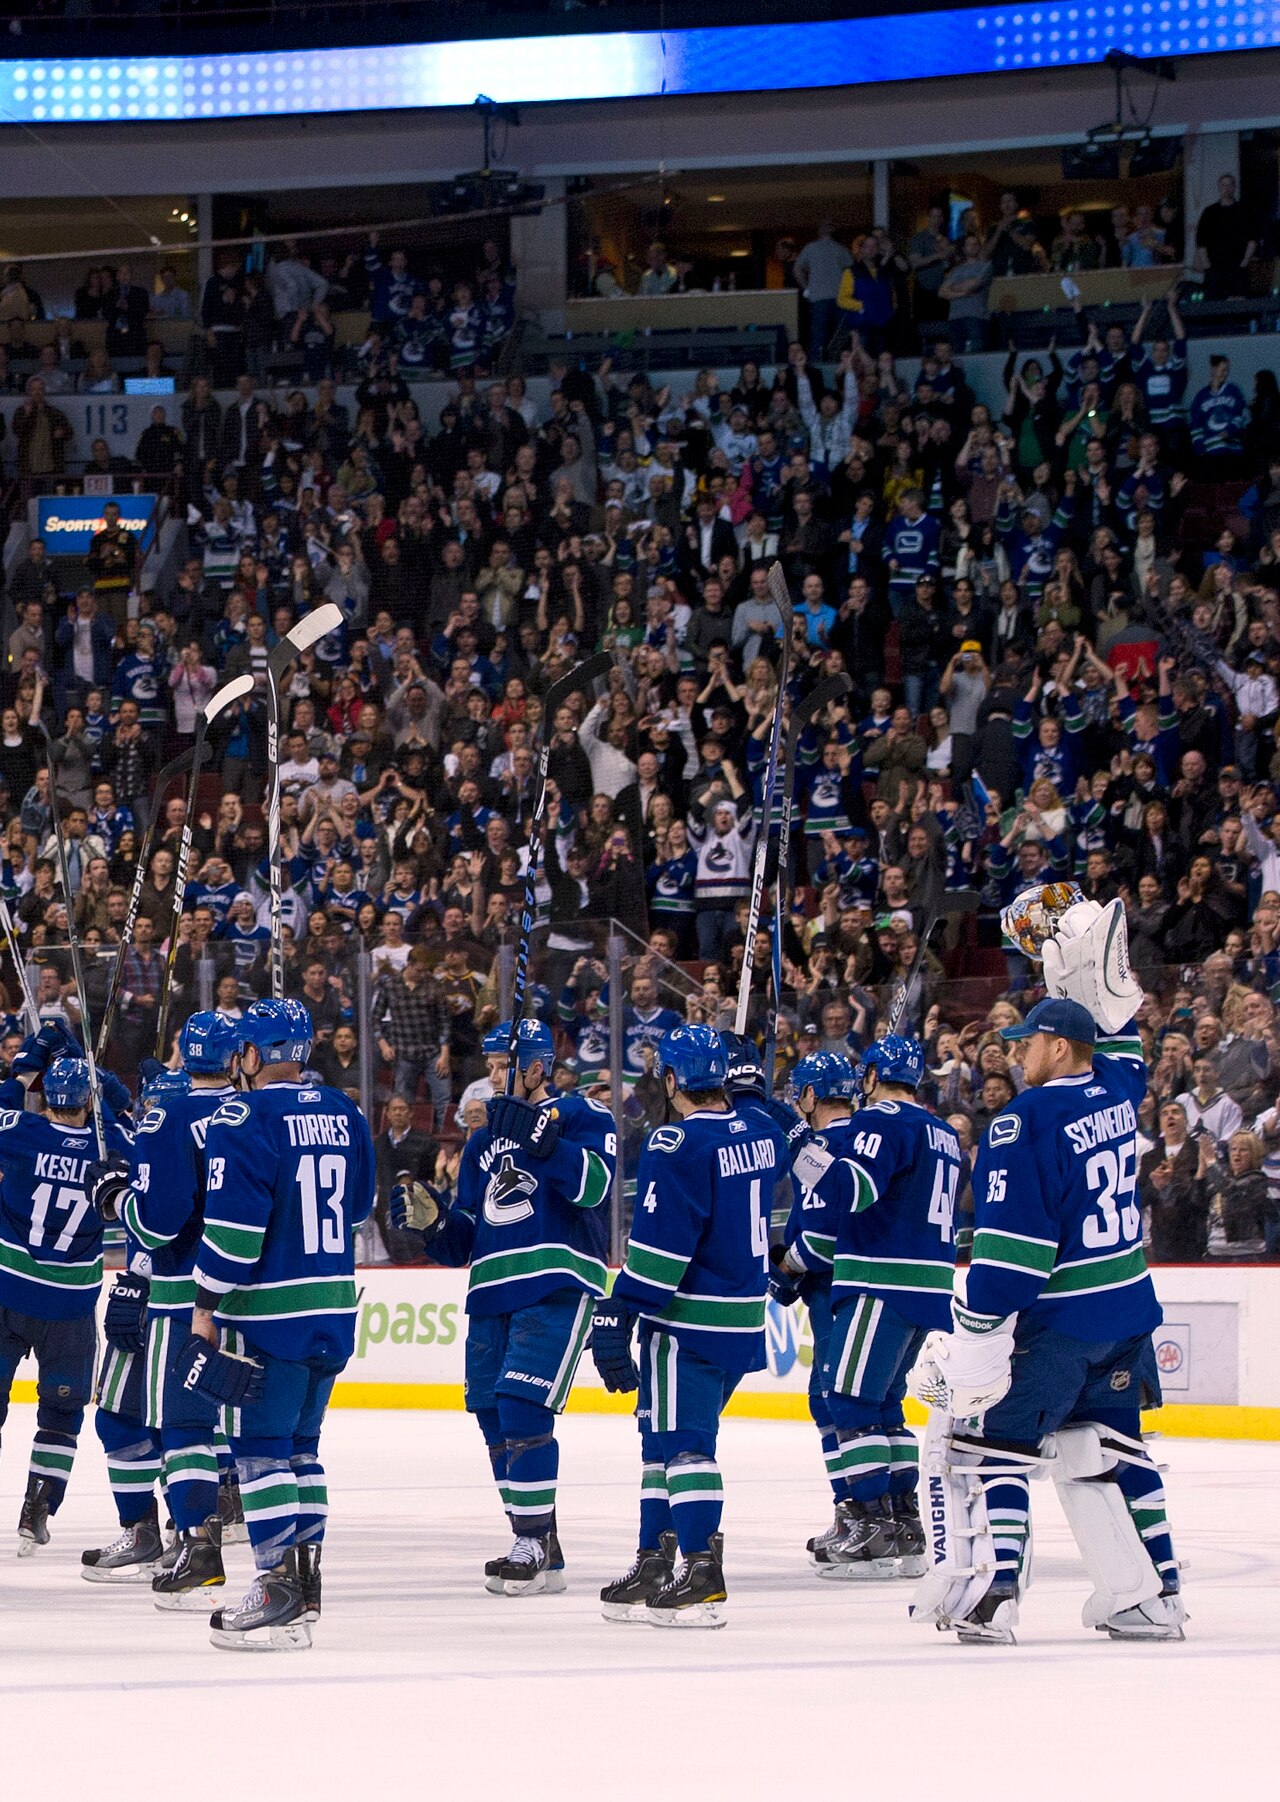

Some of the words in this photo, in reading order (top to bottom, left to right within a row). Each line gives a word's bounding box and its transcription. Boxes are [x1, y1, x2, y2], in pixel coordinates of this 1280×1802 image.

[86, 404, 128, 435] 113
[189, 1043, 203, 1056] 38
[291, 1044, 304, 1058] 13
[906, 1056, 919, 1070] 40
[709, 1060, 717, 1074] 4
[56, 1093, 67, 1105] 17
[283, 1114, 350, 1147] TORRES
[530, 1107, 552, 1144] TON
[604, 1132, 618, 1157] 6
[718, 1139, 776, 1178] BALLARD
[853, 1130, 882, 1160] 40
[642, 1181, 658, 1214] 4
[986, 1169, 1008, 1203] 35
[1082, 1139, 1142, 1249] 35
[28, 1182, 91, 1252] 17
[296, 1154, 347, 1255] 13
[749, 1178, 770, 1274] 4
[959, 1315, 993, 1331] Reebok
[183, 1352, 208, 1392] TON
[503, 1370, 555, 1390] BAUER
[931, 1475, 946, 1567] VAUGHN
